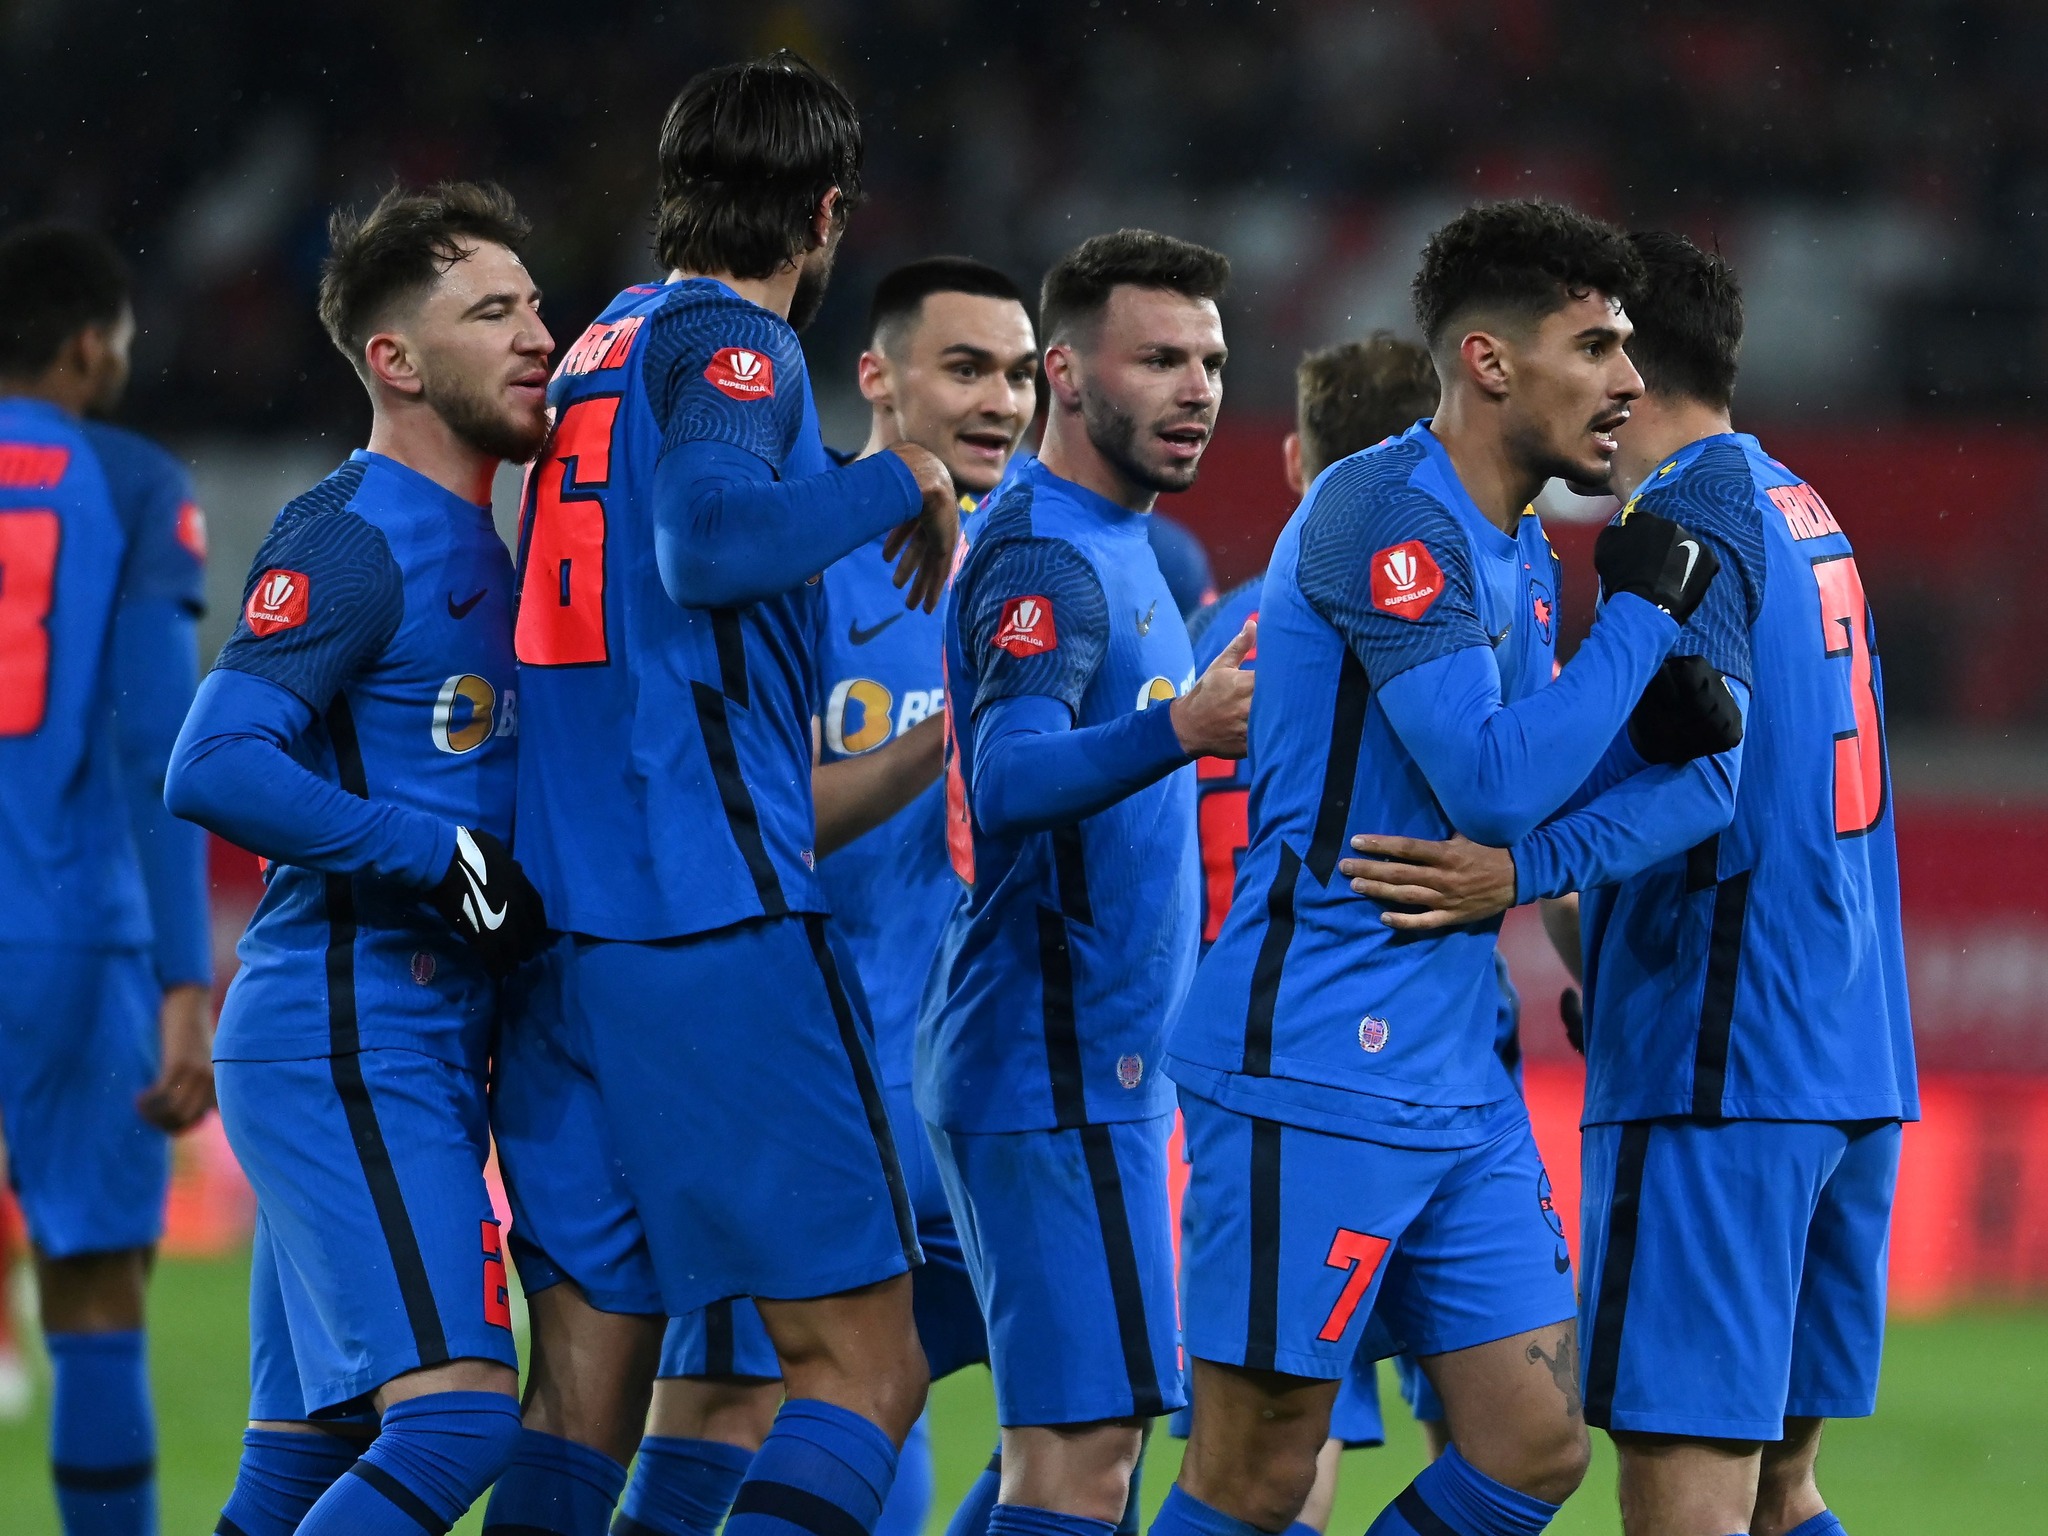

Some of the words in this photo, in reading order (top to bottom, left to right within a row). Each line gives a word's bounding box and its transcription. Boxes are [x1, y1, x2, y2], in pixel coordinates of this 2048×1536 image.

[717, 378, 766, 392] SUPERLIGA
[516, 396, 620, 665] 6
[1384, 586, 1434, 606] SUPERLIGA
[249, 611, 290, 623] SUPERLIGA
[1001, 634, 1044, 647] SUPERLIGA
[1316, 1226, 1392, 1342] 7
